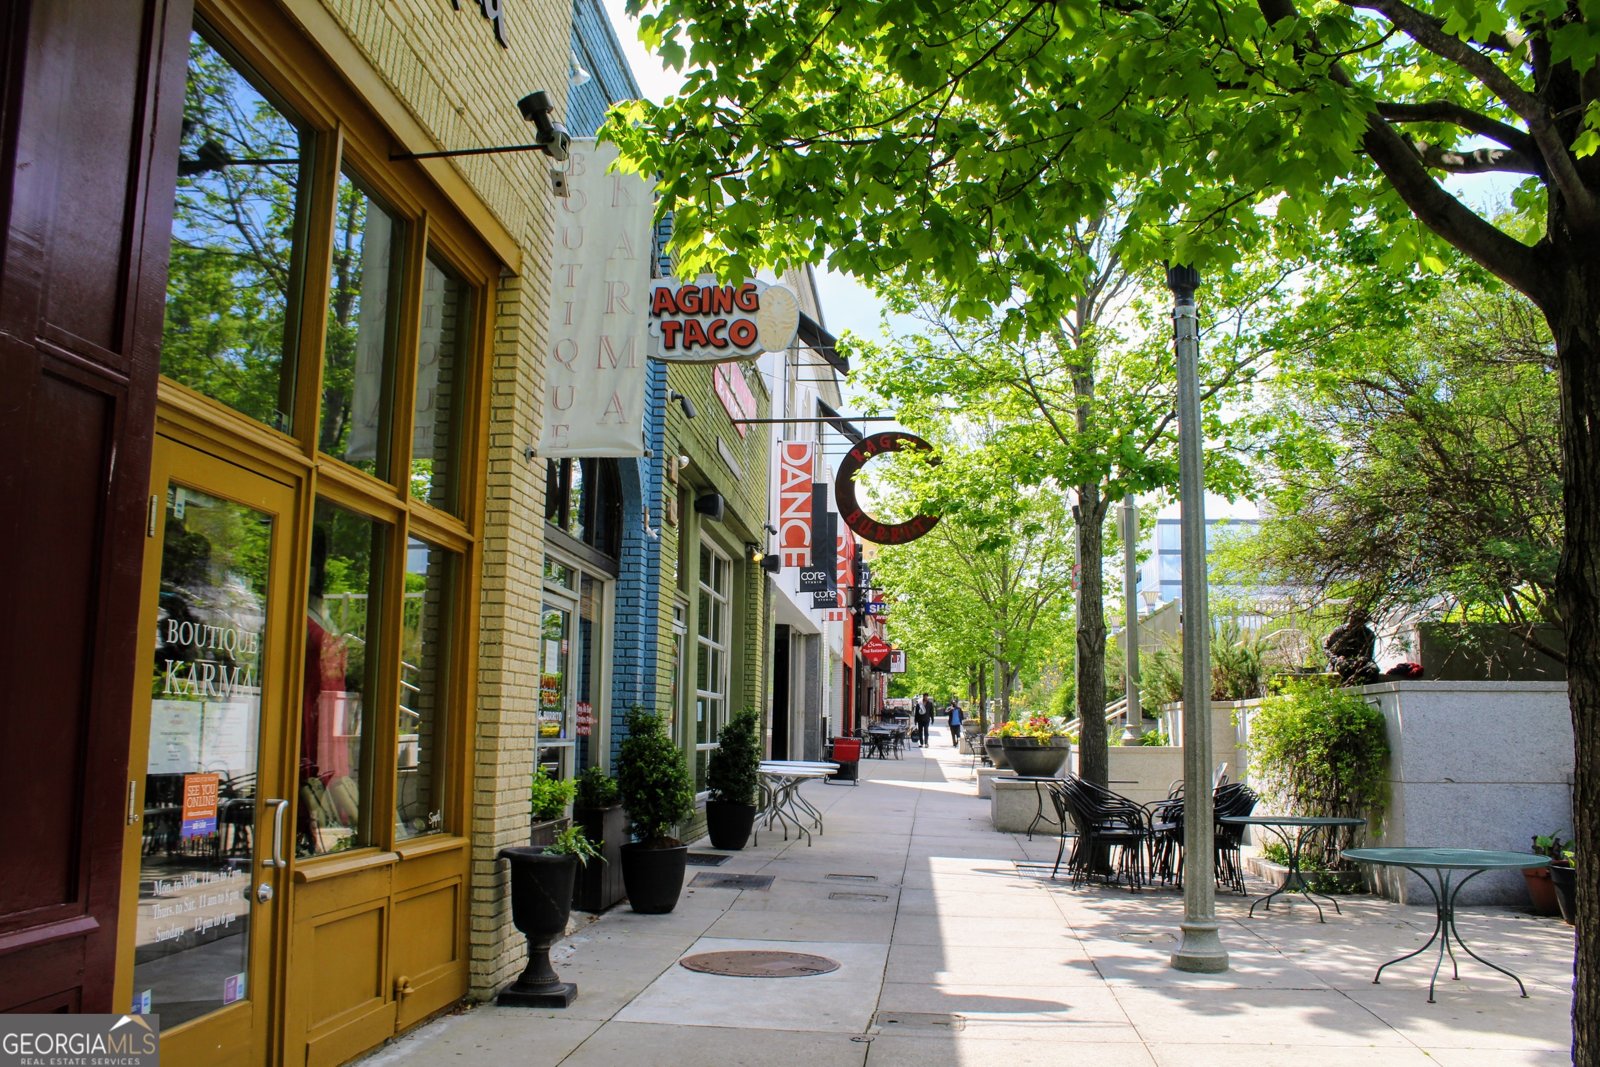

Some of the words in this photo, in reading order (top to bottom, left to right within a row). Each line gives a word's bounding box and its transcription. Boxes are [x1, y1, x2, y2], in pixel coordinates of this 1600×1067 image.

[548, 153, 587, 448] BOUTIQUE
[595, 174, 639, 425] KARMA
[649, 283, 760, 316] AGING
[660, 318, 758, 350] TACO
[780, 441, 812, 567] DANCE
[801, 571, 826, 581] core
[814, 590, 837, 599] core
[166, 618, 258, 660] BOUTIQUE
[162, 659, 255, 698] KARMA
[187, 785, 200, 796] SEE
[201, 784, 216, 796] YOU
[187, 796, 215, 808] ONLINE
